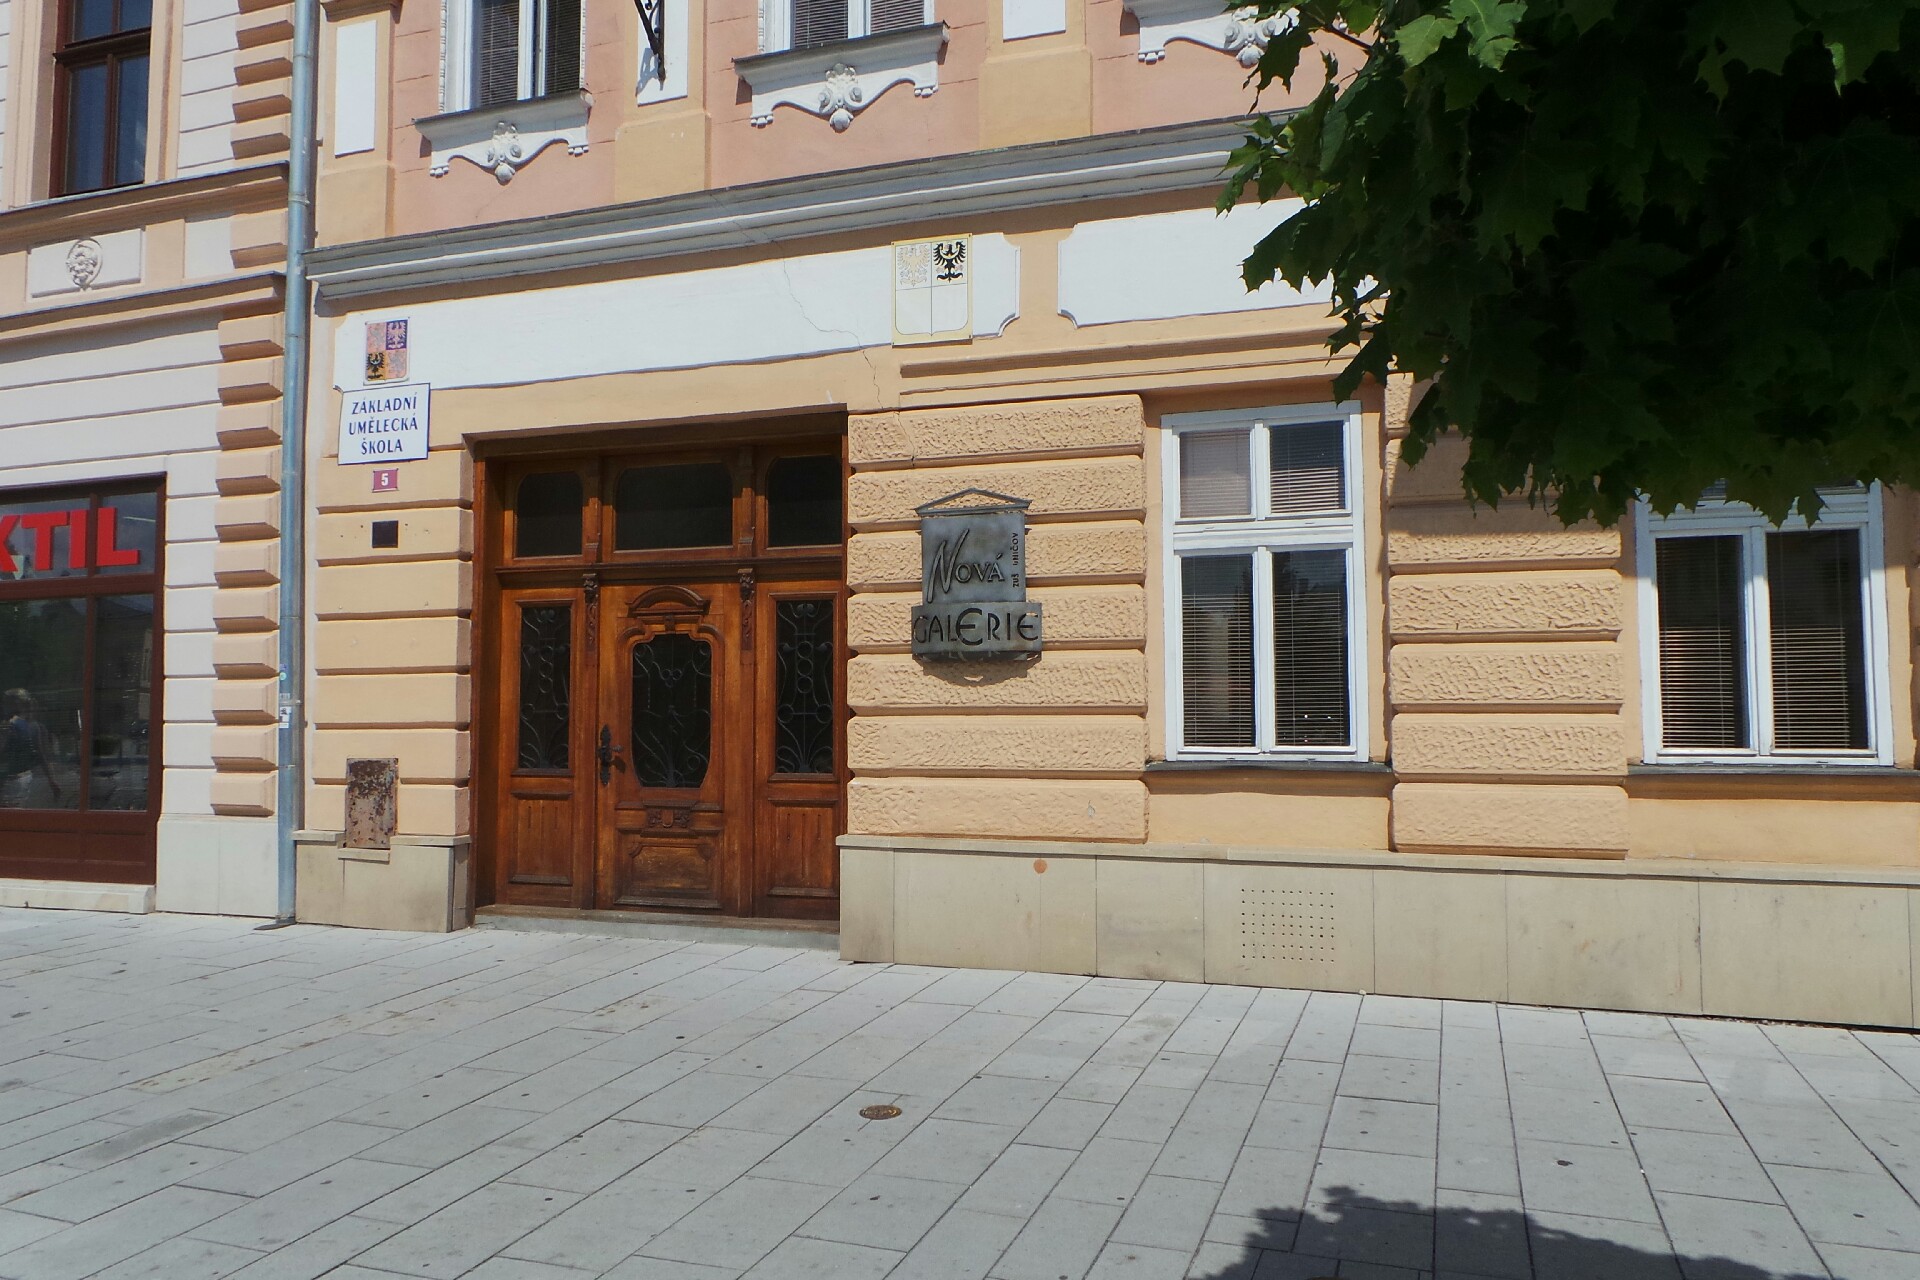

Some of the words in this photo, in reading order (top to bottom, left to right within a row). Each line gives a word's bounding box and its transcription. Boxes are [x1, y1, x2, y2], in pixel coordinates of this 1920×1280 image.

[352, 391, 417, 415] ZÁKLADNÍ
[348, 412, 418, 435] UMĚLECKÁ
[361, 437, 403, 455] ŠKOLA
[381, 473, 389, 486] 5
[926, 528, 1005, 603] NOVÁ
[912, 607, 1039, 646] GALERIE
